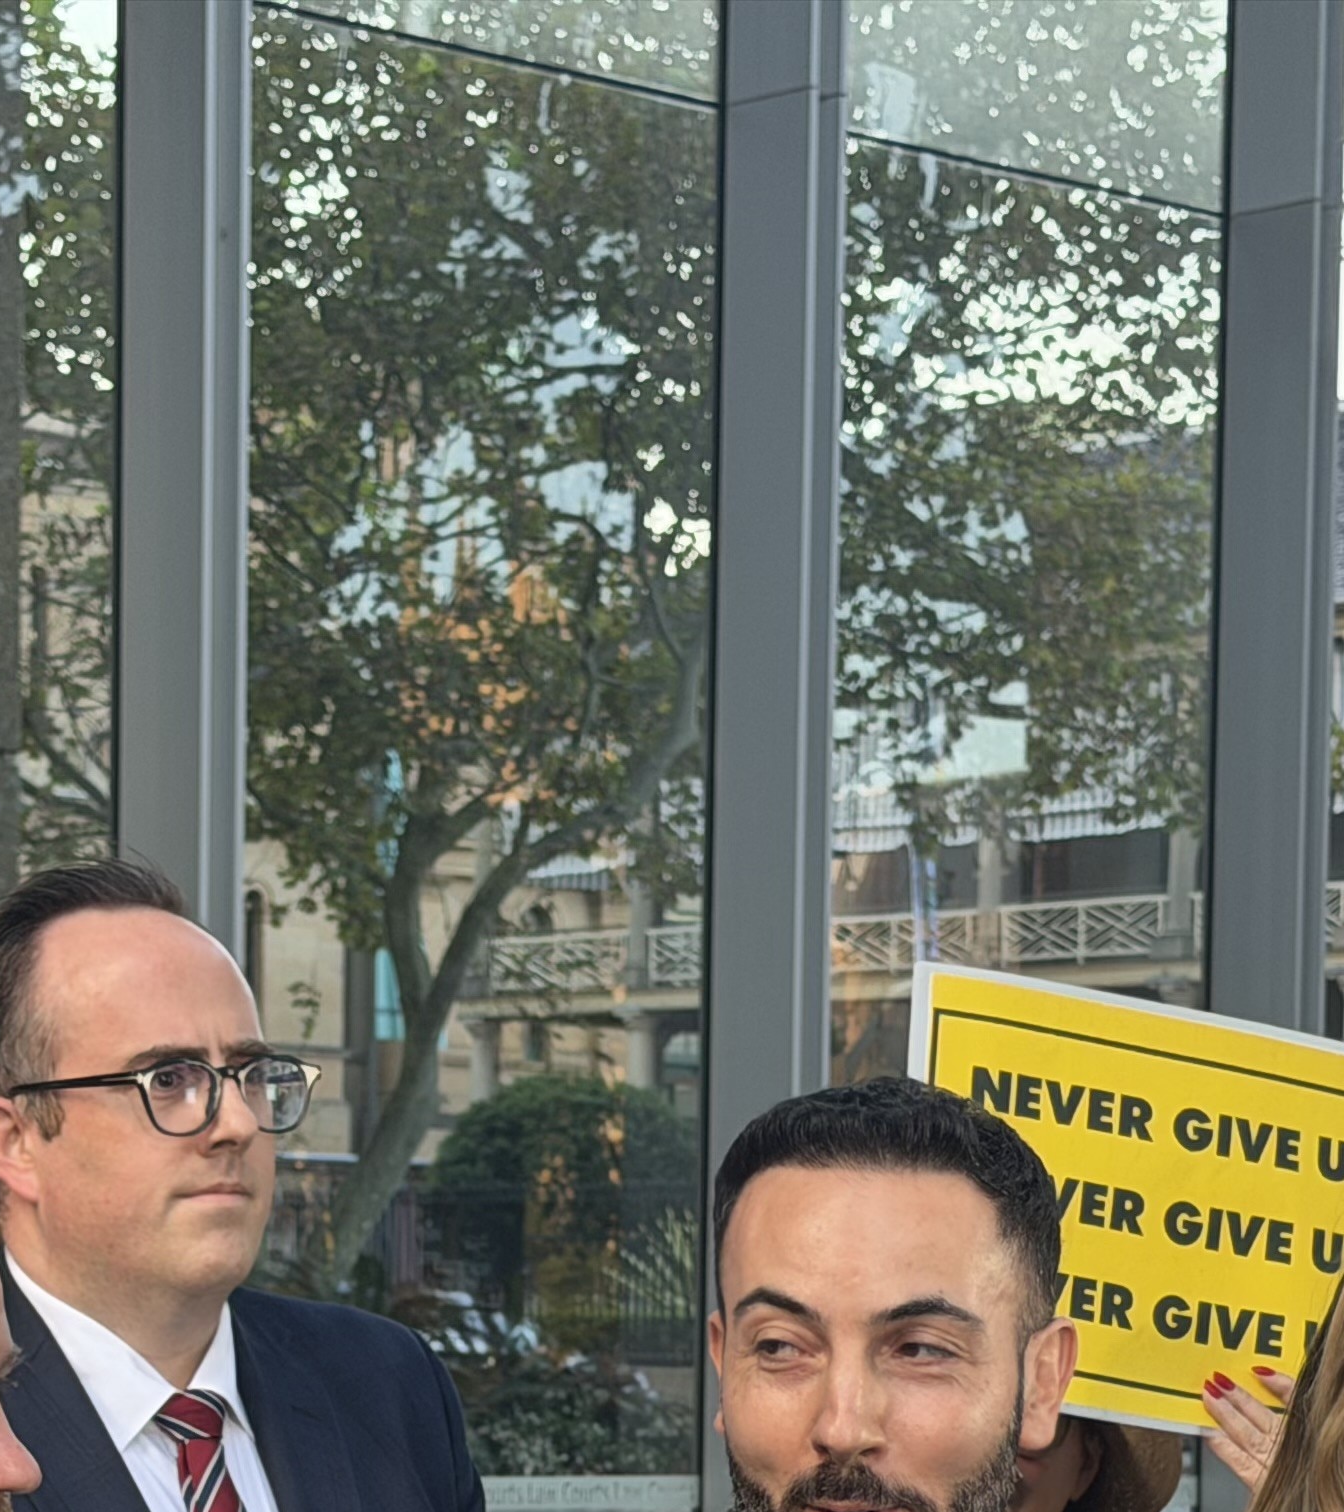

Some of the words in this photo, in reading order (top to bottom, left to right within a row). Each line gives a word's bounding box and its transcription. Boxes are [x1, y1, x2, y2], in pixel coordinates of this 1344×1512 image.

[971, 1065, 1154, 1142] NEVER
[1173, 1108, 1301, 1172] GIVE
[1163, 1200, 1295, 1265] GIVE
[1152, 1294, 1285, 1358] GIVE
